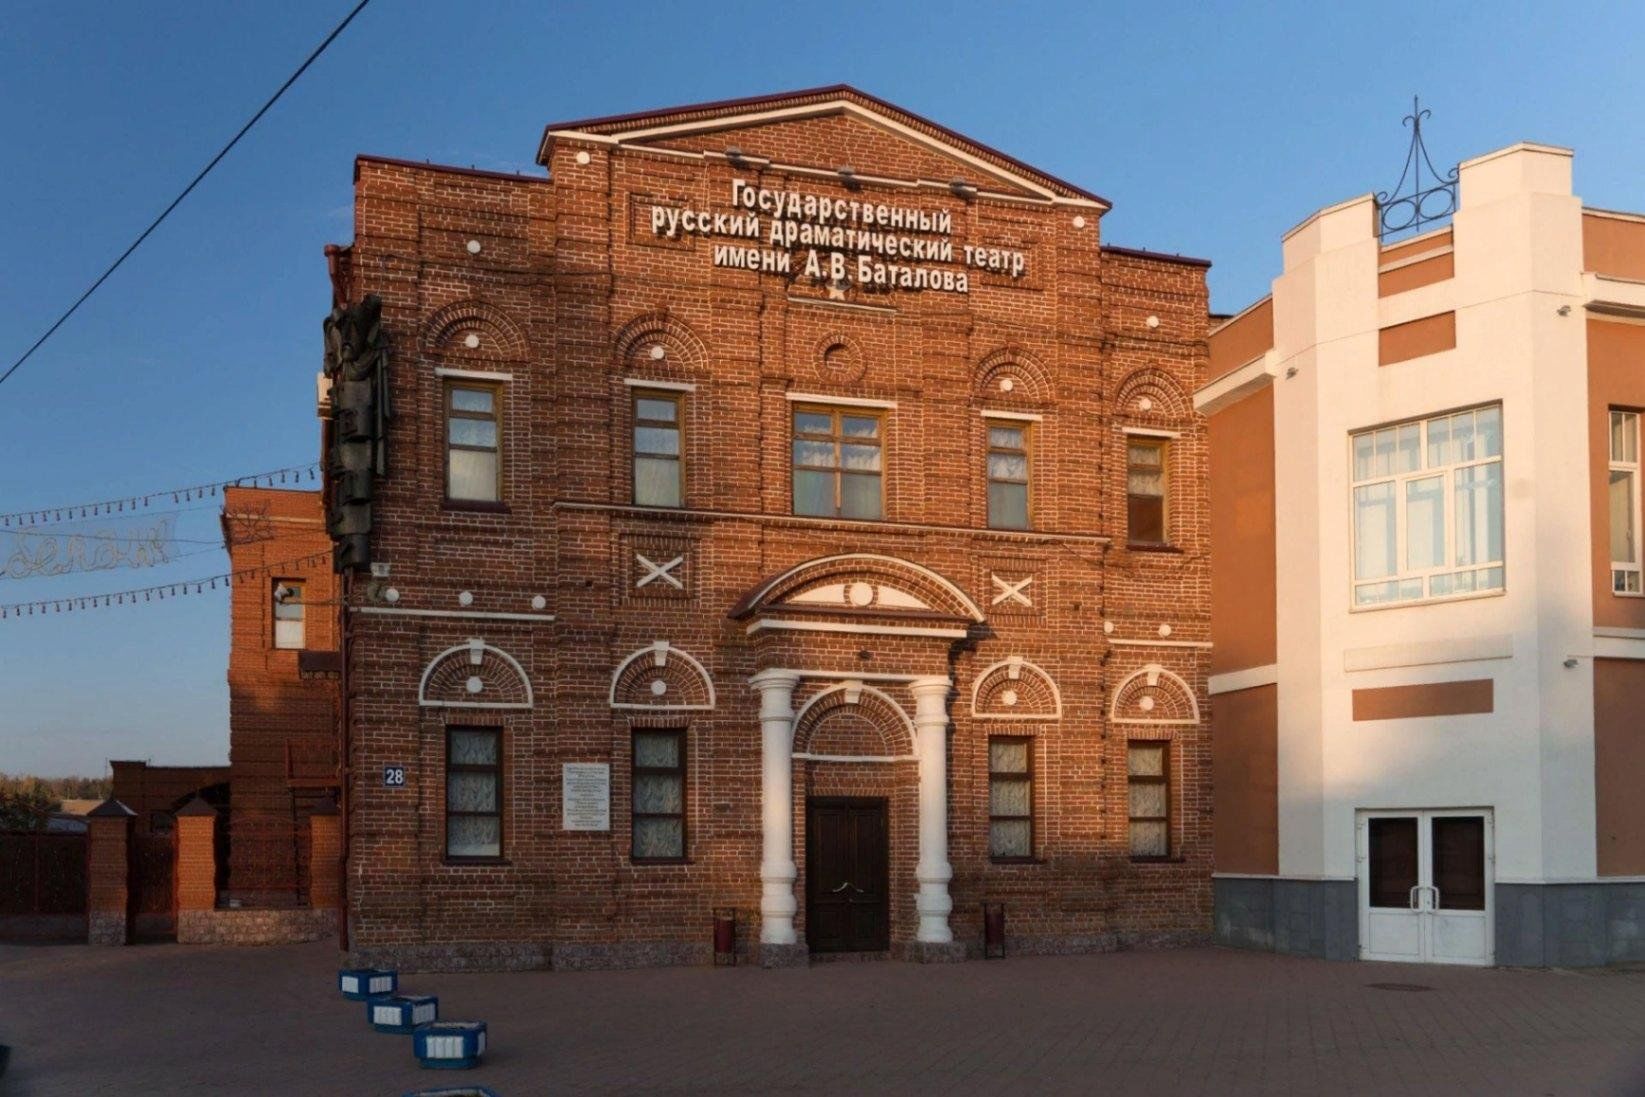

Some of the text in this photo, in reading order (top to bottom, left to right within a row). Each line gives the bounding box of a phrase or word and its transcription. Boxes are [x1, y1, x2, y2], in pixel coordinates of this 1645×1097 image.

[732, 178, 951, 234] Государственный
[651, 205, 1025, 277] русский драматический театр
[713, 245, 790, 273] имени
[386, 769, 404, 784] 28
